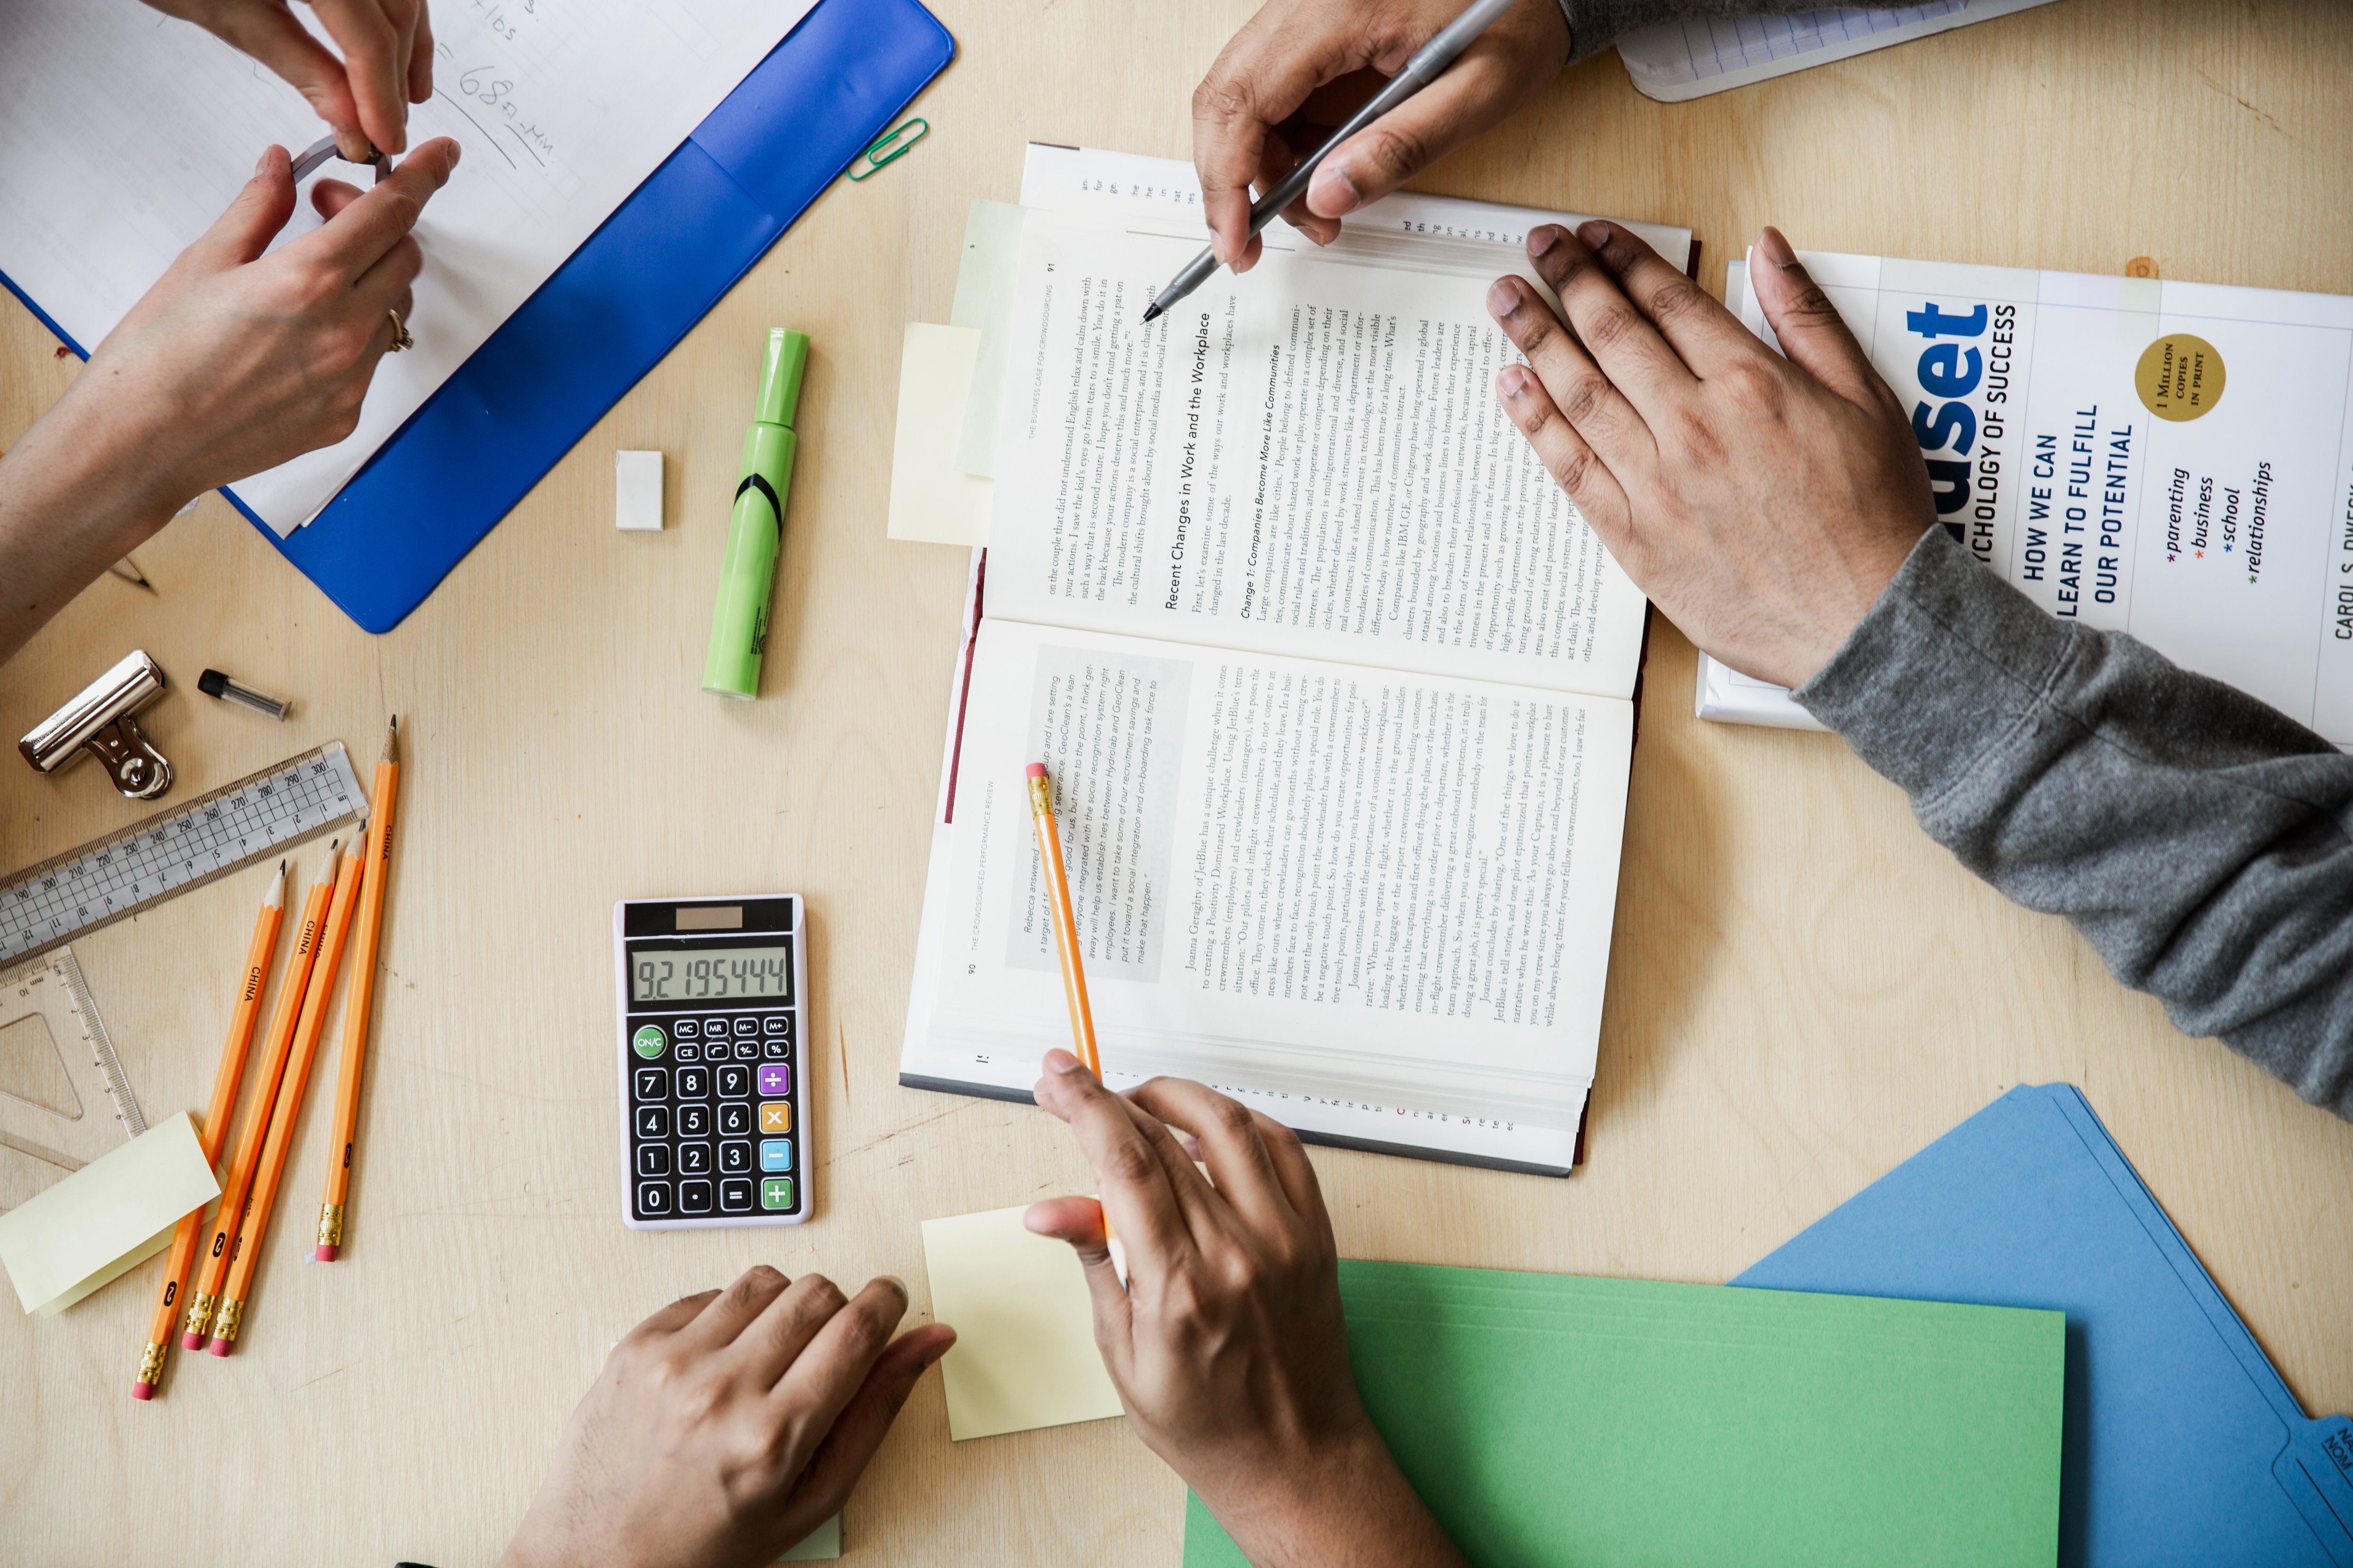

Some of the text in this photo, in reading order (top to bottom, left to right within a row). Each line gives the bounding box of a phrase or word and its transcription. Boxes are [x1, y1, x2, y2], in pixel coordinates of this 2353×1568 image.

[1047, 263, 1055, 272] 91
[1039, 284, 1053, 349] CROWDSOURCING
[1225, 295, 1236, 316] have
[1221, 319, 1235, 369] workplaces
[1986, 304, 2015, 403] SUCCESS
[1034, 367, 1043, 387] CASE
[1219, 372, 1228, 389] and
[1265, 344, 1280, 409] Communities
[1030, 388, 1040, 423] BUSINESS
[1216, 392, 1226, 415] work
[1262, 411, 1273, 432] Like
[1906, 301, 1987, 543] set
[1983, 409, 2004, 438] OF
[1165, 312, 1210, 610] Recent Changes in Work and the Workplace
[1213, 438, 1223, 460] ways
[1259, 434, 1270, 461] More
[1208, 464, 1218, 479] the
[1255, 464, 1267, 506] Become
[1207, 480, 1216, 493] of
[1206, 496, 1214, 521] some
[2023, 435, 2057, 581] HOW WE CAN
[2057, 405, 2097, 617] LEARN TO FULFILL
[2094, 424, 2132, 603] OUR POTENTIAL
[1201, 525, 1211, 565] examine
[1247, 507, 1262, 566] Companies
[1208, 495, 1231, 615] changed in the last decade.
[1195, 569, 1206, 588] let’s
[1191, 590, 1205, 613] First,
[1241, 580, 1255, 619] Change
[1149, 680, 1157, 689] to
[1235, 667, 1244, 687] terms
[1144, 691, 1155, 714] force
[1227, 691, 1240, 732] JetBlue’s
[1144, 716, 1152, 734] task
[1223, 733, 1238, 761] Using
[1137, 736, 1152, 794] on-boarding
[1135, 794, 1144, 814] and
[1217, 765, 1232, 819] Workplace.
[13, 762, 326, 902] 190 200 210 220 230 240 250 260 270 280 290 300
[382, 824, 393, 861] CHINA
[1129, 816, 1141, 866] integration
[1210, 823, 1225, 878] Dominated
[23, 929, 34, 940] 12
[51, 917, 62, 928] 11
[78, 905, 89, 917] 10
[107, 895, 112, 905] 9
[132, 883, 139, 893] 8
[161, 871, 167, 882] 7
[187, 860, 193, 870] 6
[214, 848, 221, 858] 5
[241, 838, 246, 846] 4
[267, 825, 274, 835] 3
[294, 814, 301, 823] 2
[322, 803, 327, 811] 1
[968, 964, 976, 974] 90
[973, 869, 985, 935] CROWDSOURCED
[979, 810, 991, 868] PERFORMANCE
[985, 780, 993, 809] REVIEW
[1127, 867, 1136, 894] social
[1206, 881, 1222, 926] Positivity
[1123, 902, 1133, 936] toward
[1136, 873, 1153, 964] make that happen.”
[299, 920, 315, 955] CHINA
[1121, 946, 1130, 963] put
[1204, 937, 1217, 976] creating
[19, 988, 30, 997] 10
[30, 977, 44, 986] mm
[244, 966, 261, 1002] CHINA
[638, 958, 784, 999] 9.2195444
[1202, 979, 1209, 989] to
[637, 1037, 661, 1047] ON/C
[678, 1025, 693, 1033] MC
[681, 1048, 693, 1057] CE
[644, 1073, 738, 1093] 7 8 9
[646, 1111, 739, 1131] 4 5 6
[648, 1149, 740, 1168] 1 2 3
[648, 1190, 659, 1207] 0
[2324, 1435, 2353, 1471] NOM
[2337, 1427, 2353, 1455] NA
